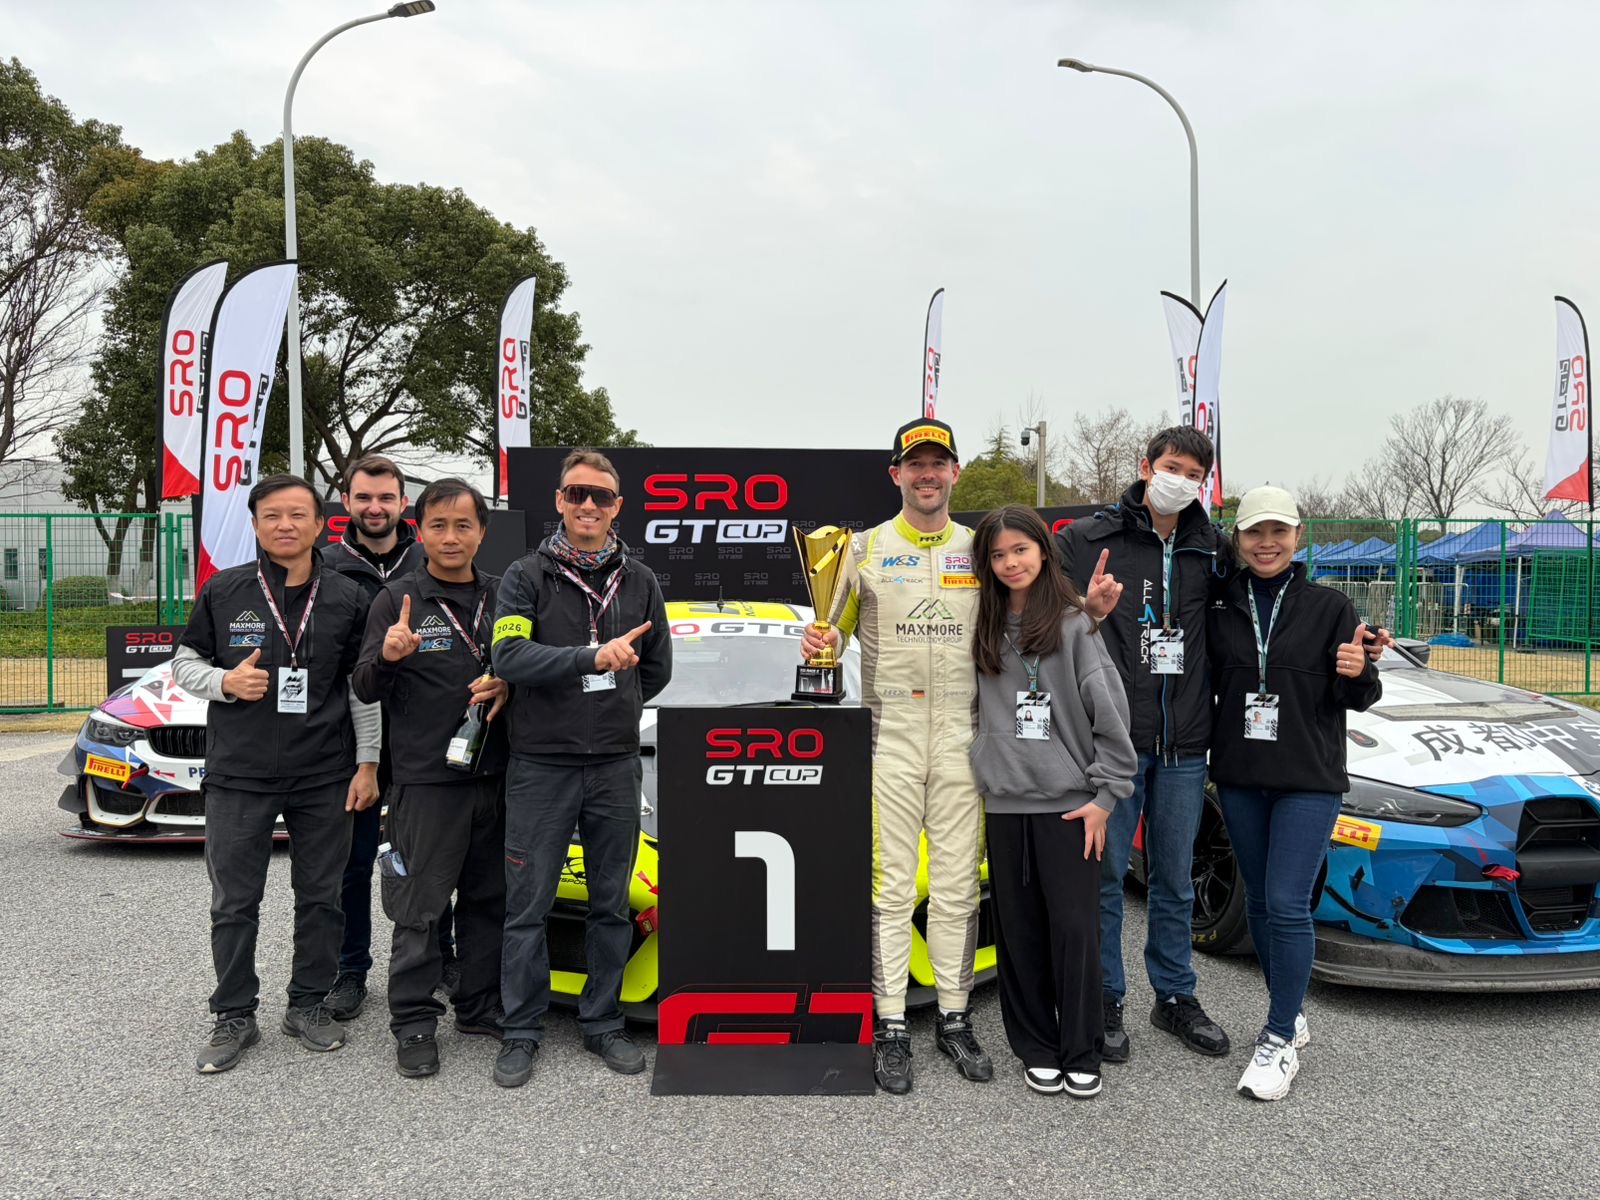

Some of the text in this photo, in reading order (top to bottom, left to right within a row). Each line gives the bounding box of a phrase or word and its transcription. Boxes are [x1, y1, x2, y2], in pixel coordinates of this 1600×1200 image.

[169, 329, 195, 417] SRO
[502, 337, 519, 419] SRO
[214, 369, 252, 492] SRO
[644, 473, 788, 511] SRO
[644, 519, 717, 544] GT
[721, 522, 785, 541] CUP
[668, 546, 694, 554] SRO
[718, 546, 743, 554] SRO
[766, 546, 792, 554] SRO
[882, 554, 921, 568] W&S
[945, 556, 970, 564] SRO
[694, 572, 719, 580] SRO
[744, 572, 768, 580] SRO
[496, 623, 522, 634] 2026
[710, 622, 781, 635] GT
[895, 623, 964, 636] MAXMORE
[125, 632, 174, 645] SRO
[125, 645, 149, 654] GT
[705, 728, 824, 759] SRO
[88, 758, 126, 777] PIRELLI
[705, 765, 820, 785] GT CUP
[734, 831, 796, 951] 1
